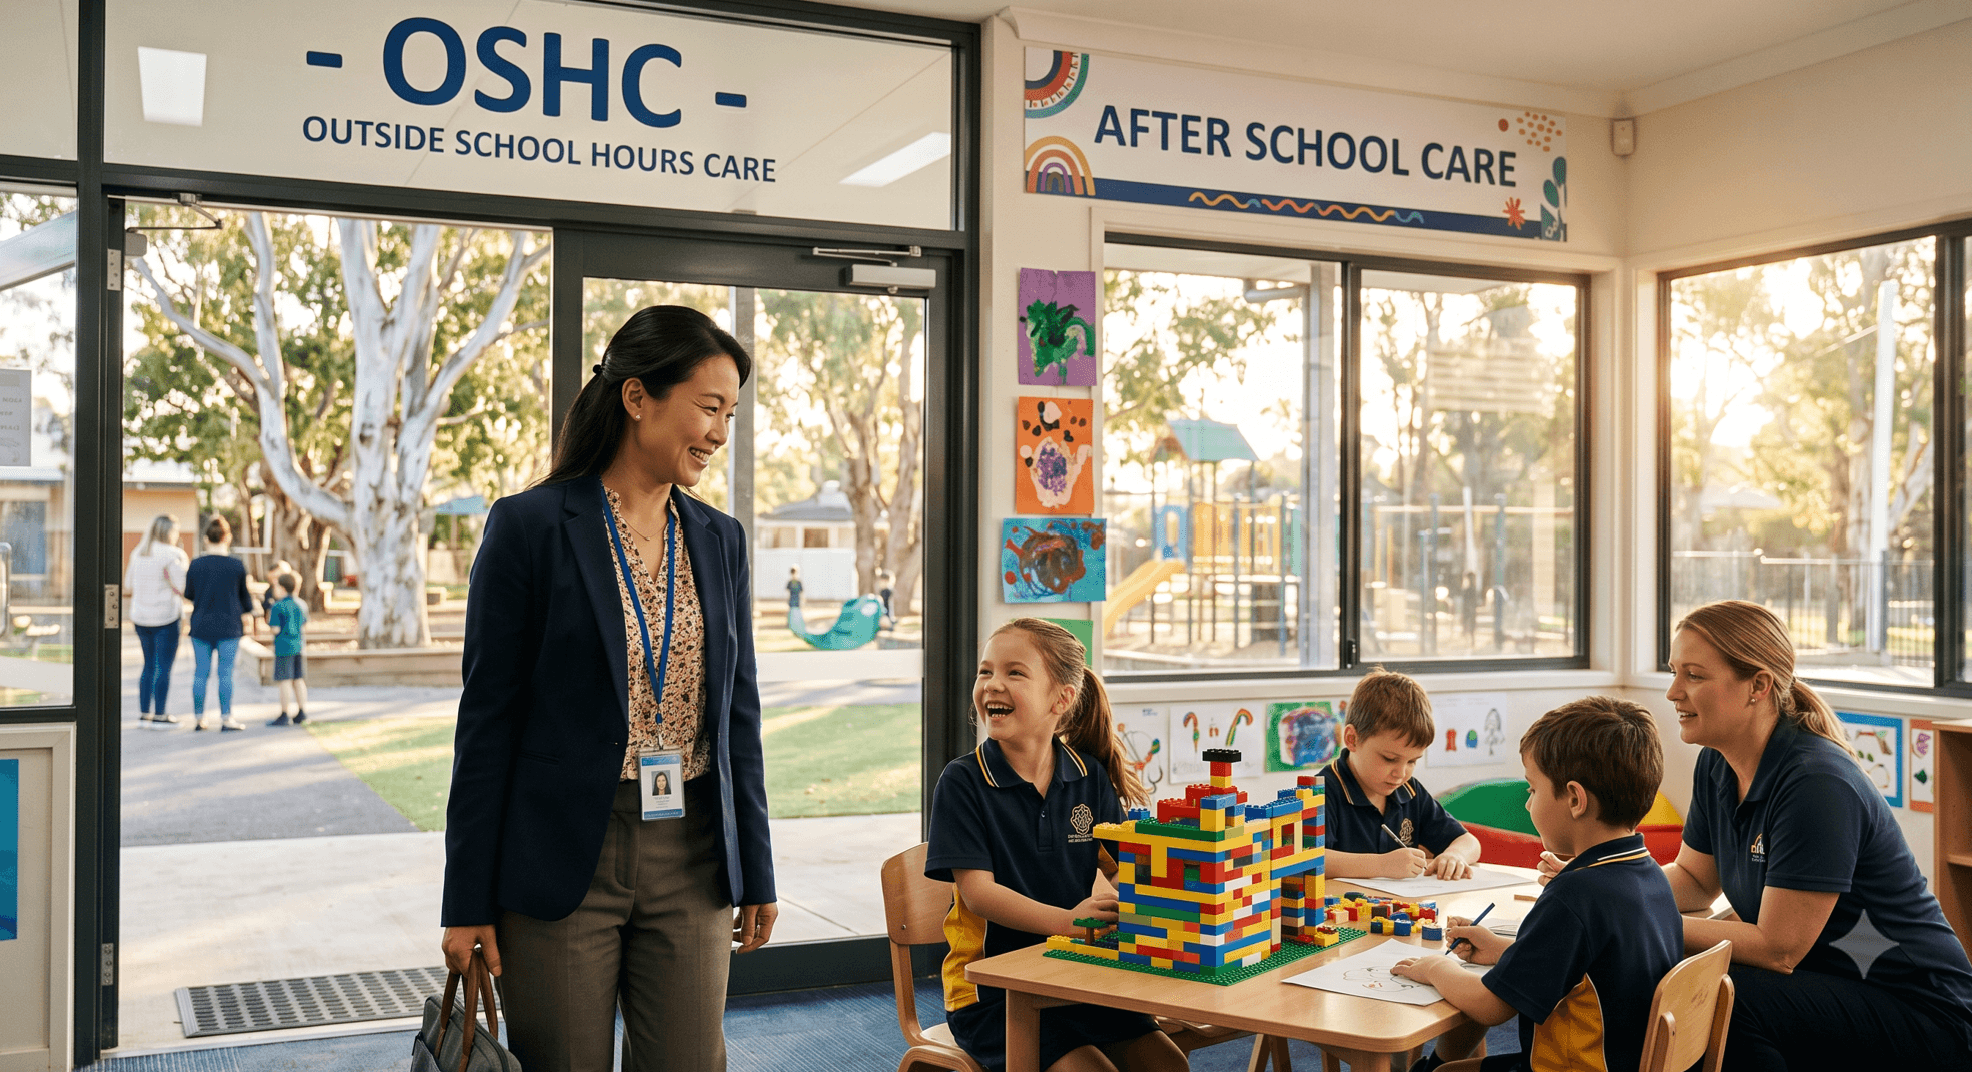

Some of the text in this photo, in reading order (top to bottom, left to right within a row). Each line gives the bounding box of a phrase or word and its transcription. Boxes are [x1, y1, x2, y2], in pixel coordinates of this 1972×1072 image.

[382, 16, 683, 129] OSHC
[302, 115, 777, 183] OUTSIDE SCHOOL HOURS CARE
[1094, 104, 1517, 188] AFTER SCHOOL CARE
